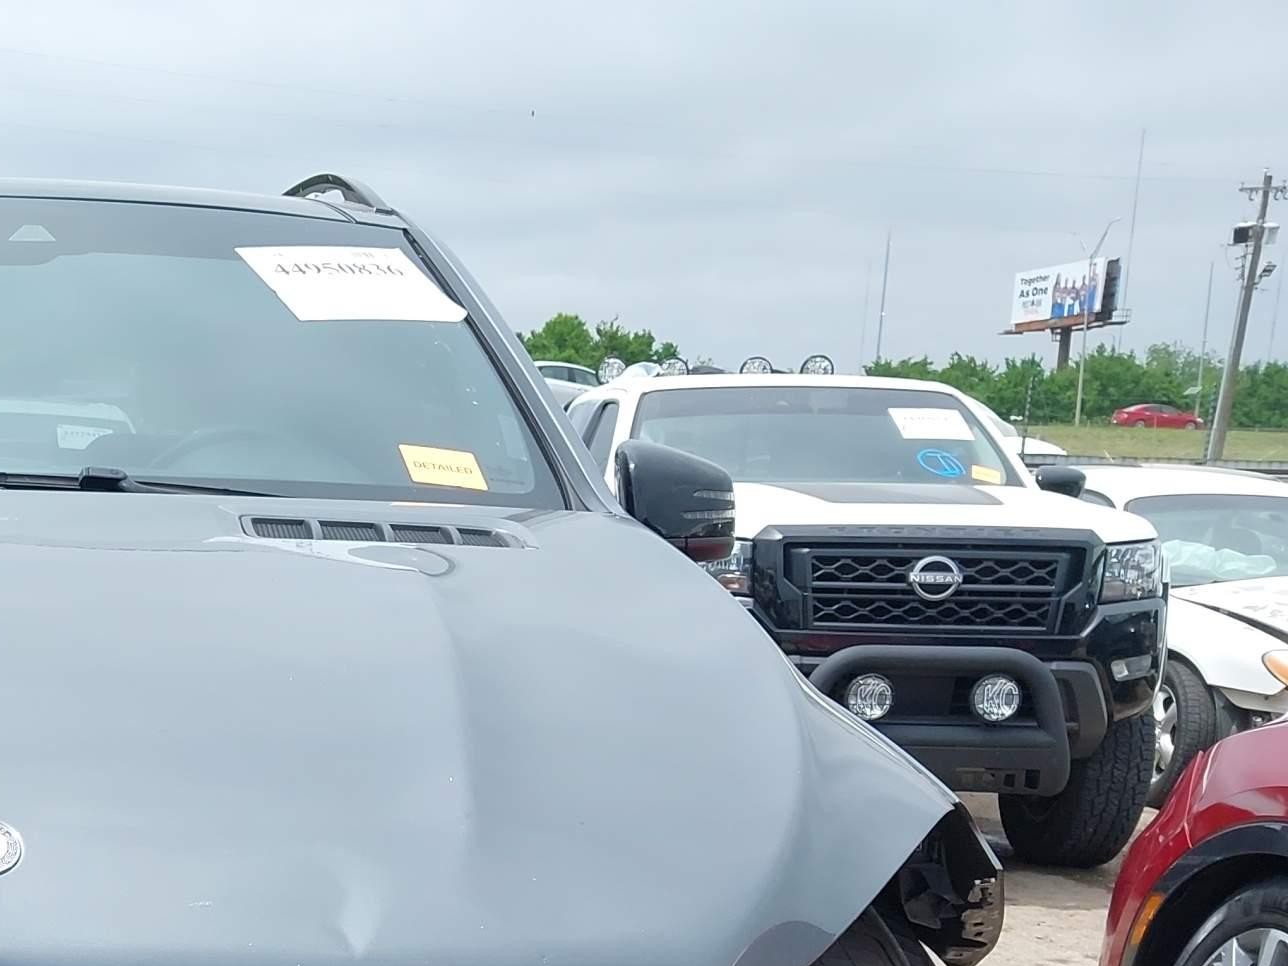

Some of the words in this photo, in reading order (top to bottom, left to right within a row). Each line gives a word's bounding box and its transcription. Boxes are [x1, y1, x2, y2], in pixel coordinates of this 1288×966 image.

[274, 262, 404, 277] 44950836
[1020, 275, 1050, 286] Together
[1019, 290, 1030, 299] As
[1032, 287, 1048, 297] One
[413, 460, 473, 475] DETAILED
[910, 573, 962, 583] NISSAN
[857, 680, 892, 716] KC
[984, 680, 1019, 716] KC
